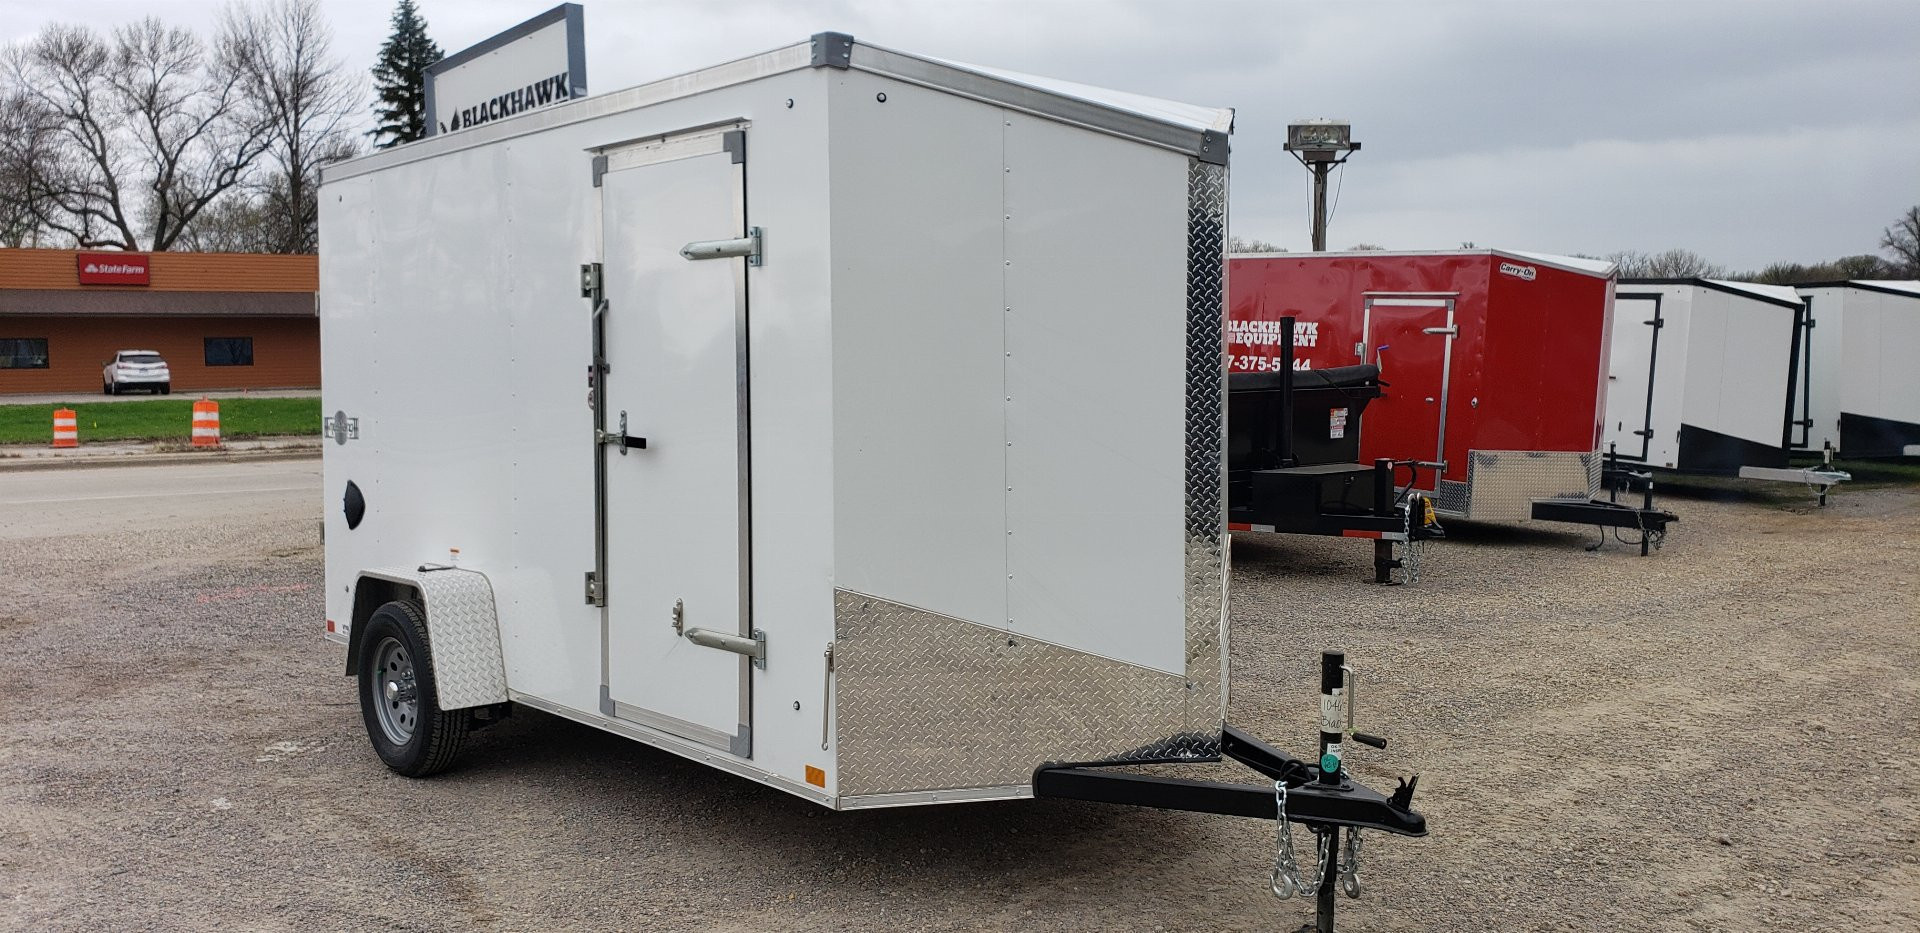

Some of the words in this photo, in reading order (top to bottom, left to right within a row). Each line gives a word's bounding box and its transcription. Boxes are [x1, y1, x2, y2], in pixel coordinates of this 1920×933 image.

[462, 72, 568, 129] BLACKHAWK
[98, 263, 121, 274] State
[122, 264, 145, 275] Farm
[1500, 263, 1534, 277] Carry-On
[1227, 320, 1318, 335] BLACKHWK
[1236, 332, 1318, 348] EQUIPENT
[1227, 355, 1311, 372] 7-375-544
